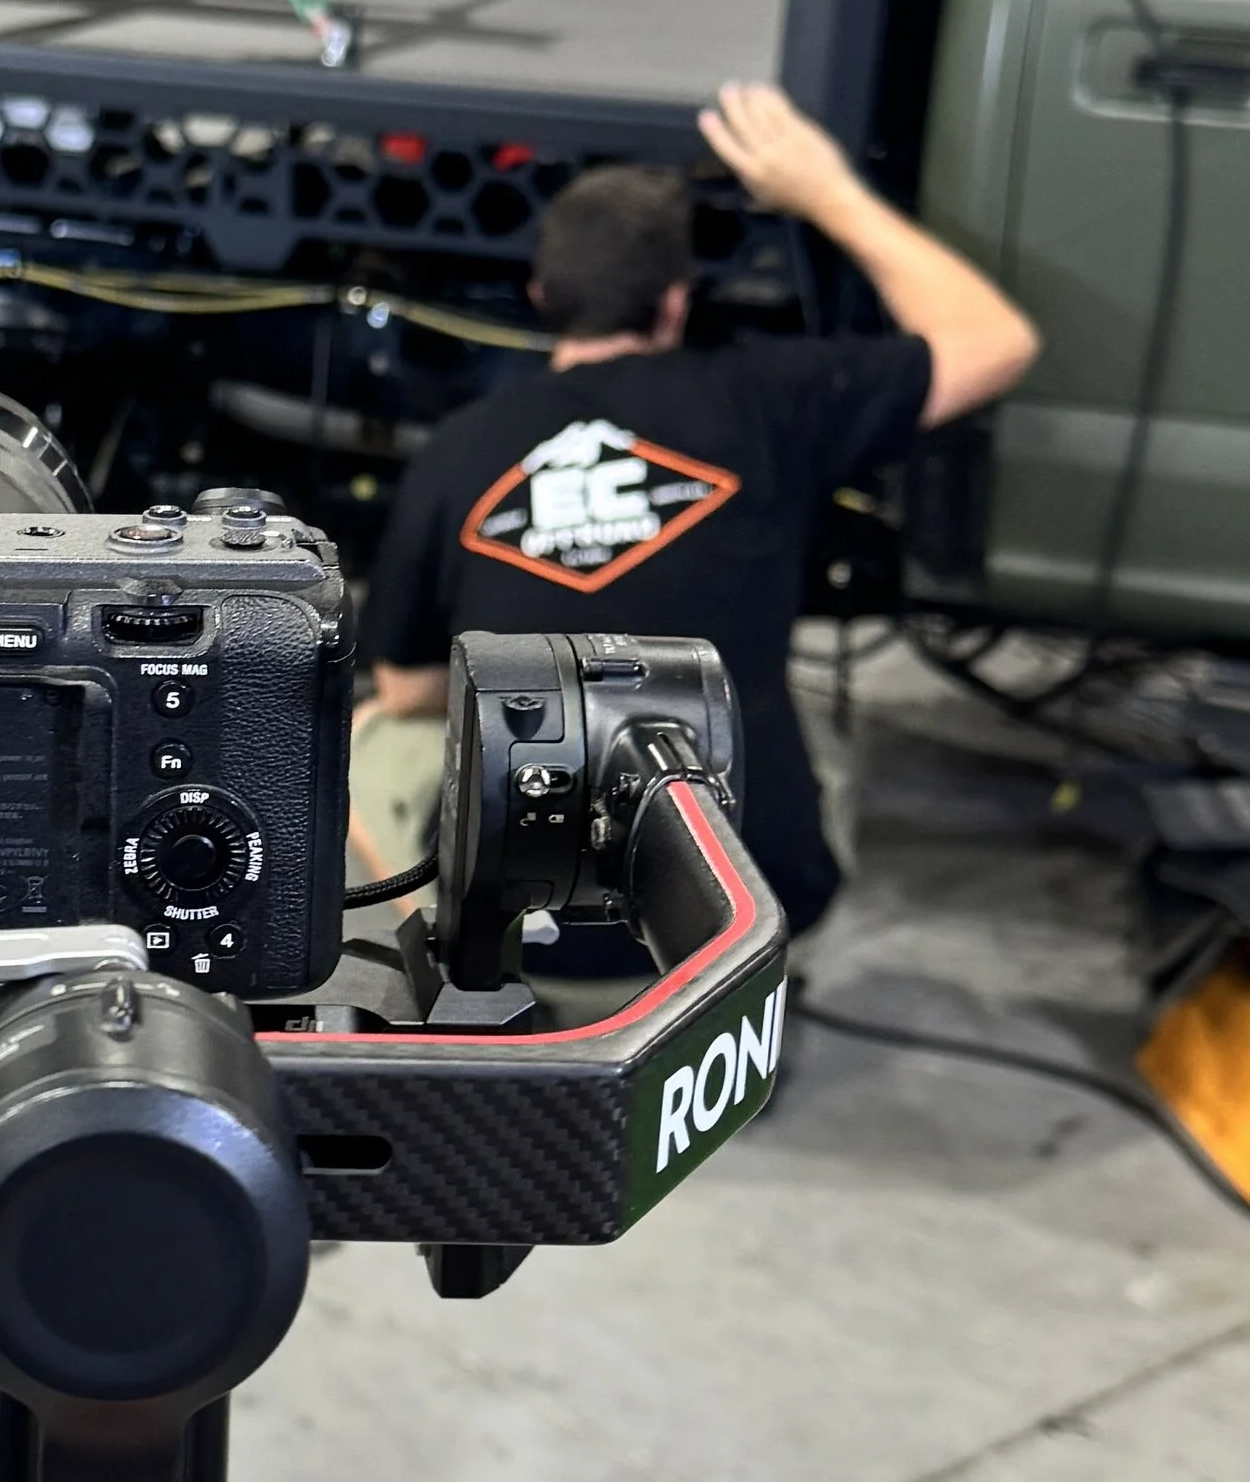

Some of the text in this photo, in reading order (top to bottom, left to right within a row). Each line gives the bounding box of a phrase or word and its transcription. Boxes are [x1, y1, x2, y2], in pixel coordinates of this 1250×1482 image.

[530, 457, 649, 531] EC
[140, 663, 209, 676] FOCUS MAG
[165, 691, 180, 709] 5
[160, 754, 182, 770] Fn
[179, 791, 210, 805] DISP
[123, 837, 140, 875] ZEBRA
[245, 831, 264, 882] PEAKING
[163, 905, 220, 921] SHUTTER
[219, 932, 235, 949] 4
